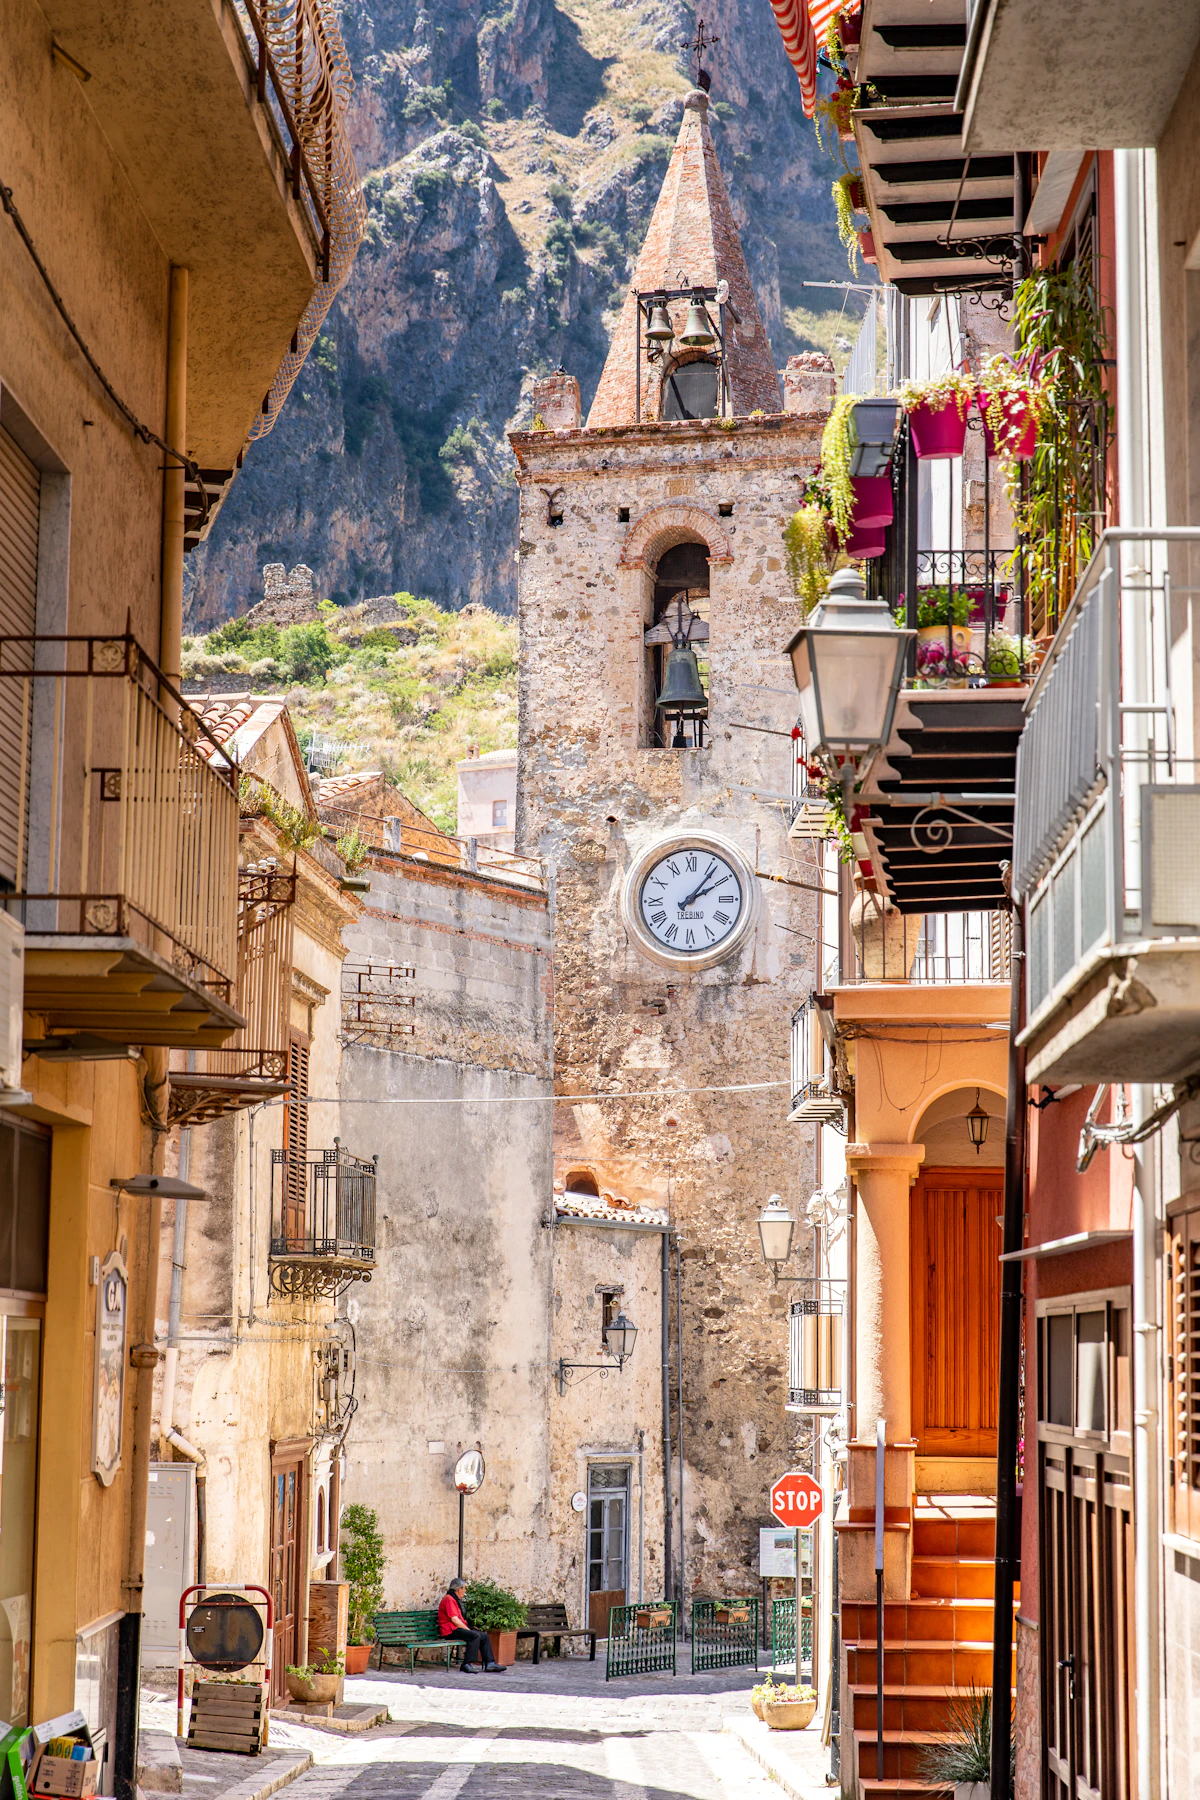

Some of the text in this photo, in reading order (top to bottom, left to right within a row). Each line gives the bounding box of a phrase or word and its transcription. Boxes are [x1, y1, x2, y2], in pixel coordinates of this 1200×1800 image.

[667, 861, 681, 878] XI
[686, 857, 697, 872] XII
[653, 877, 668, 890] X
[677, 911, 704, 919] TREBINO
[704, 924, 715, 939] V
[774, 1490, 820, 1511] STOP
